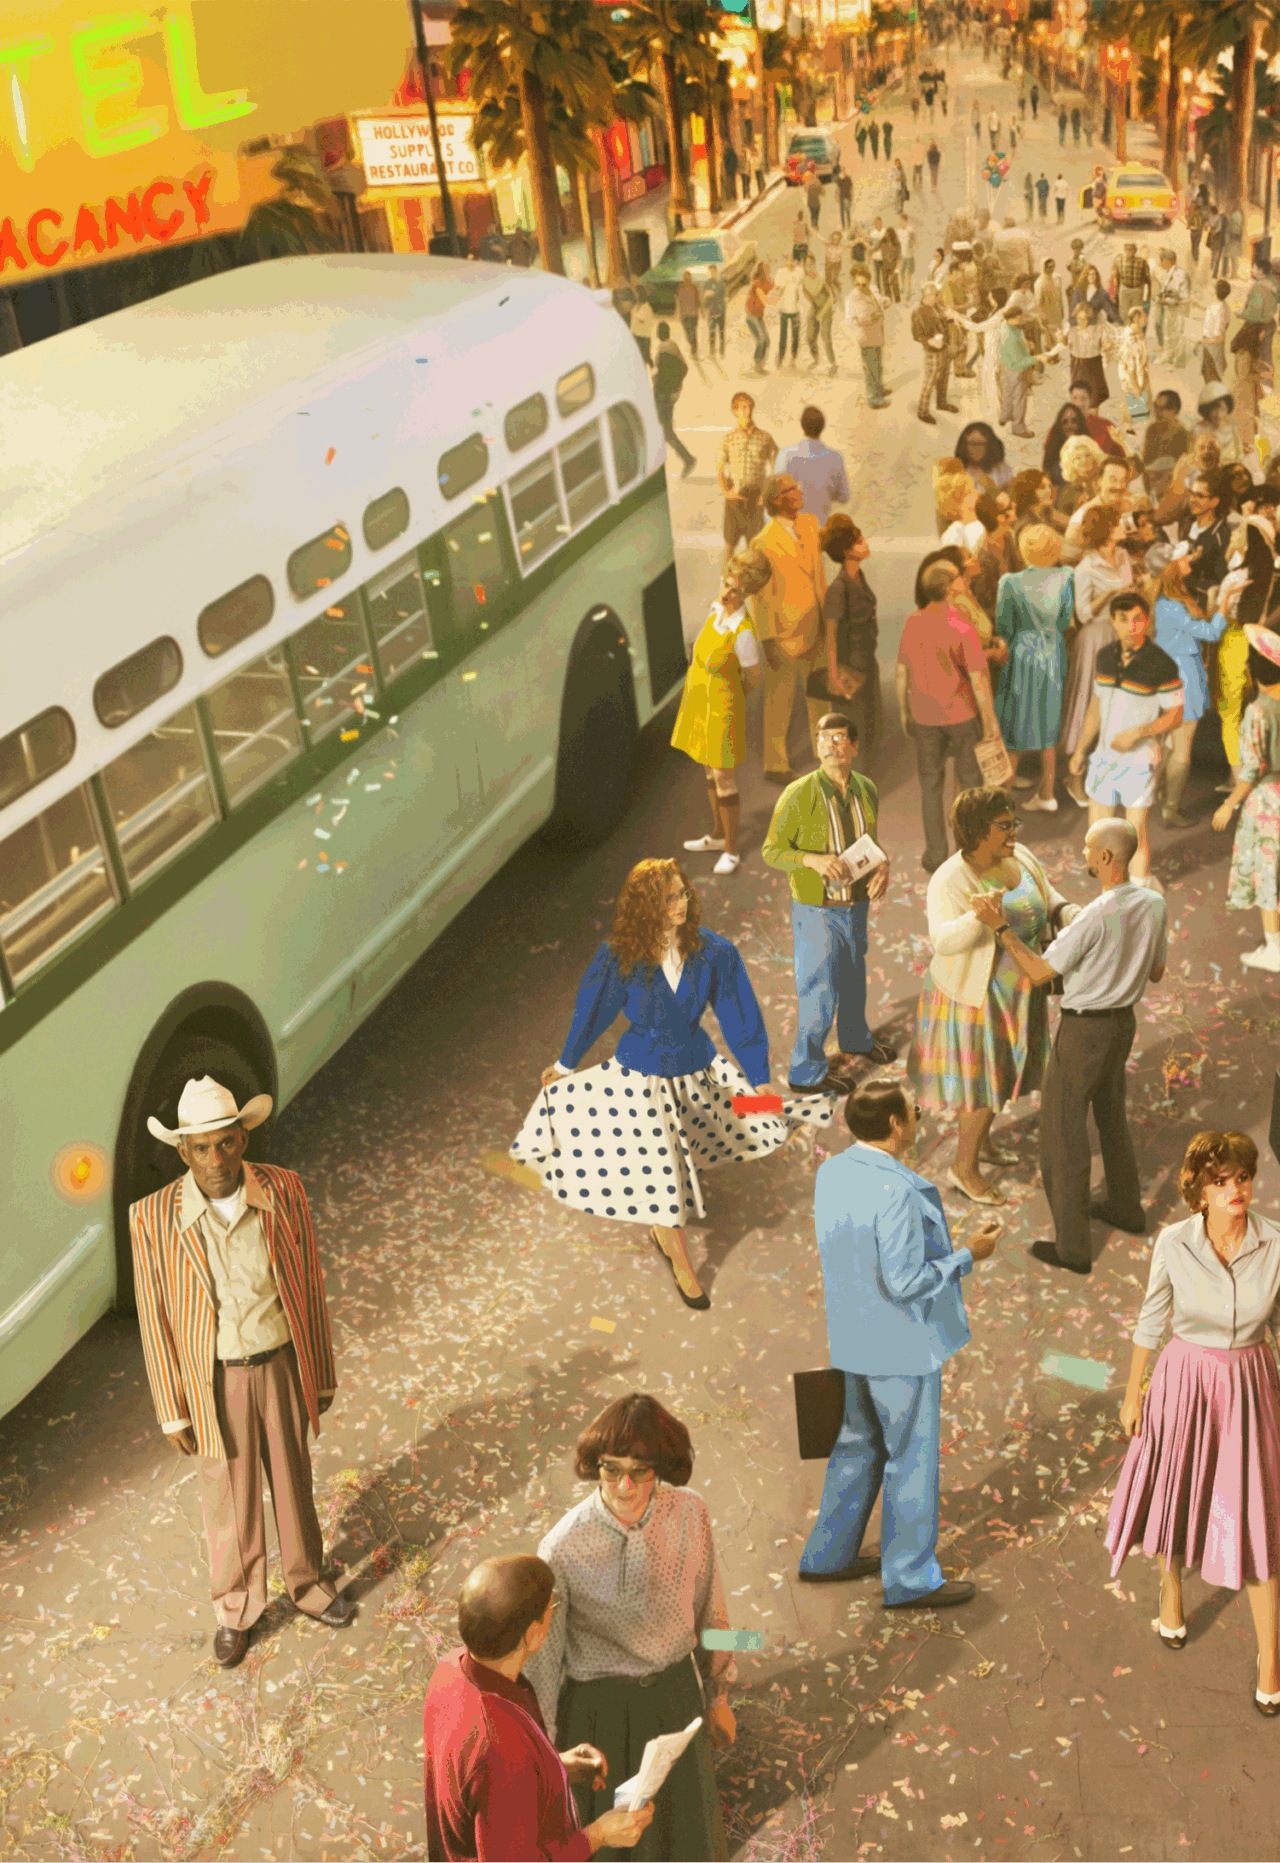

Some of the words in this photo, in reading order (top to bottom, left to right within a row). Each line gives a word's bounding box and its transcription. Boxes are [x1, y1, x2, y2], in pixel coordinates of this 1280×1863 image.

[373, 123, 455, 140] HOLLYWOD
[389, 142, 455, 159] SUPPLS
[368, 160, 454, 179] RESTAURAT
[457, 161, 475, 174] CO
